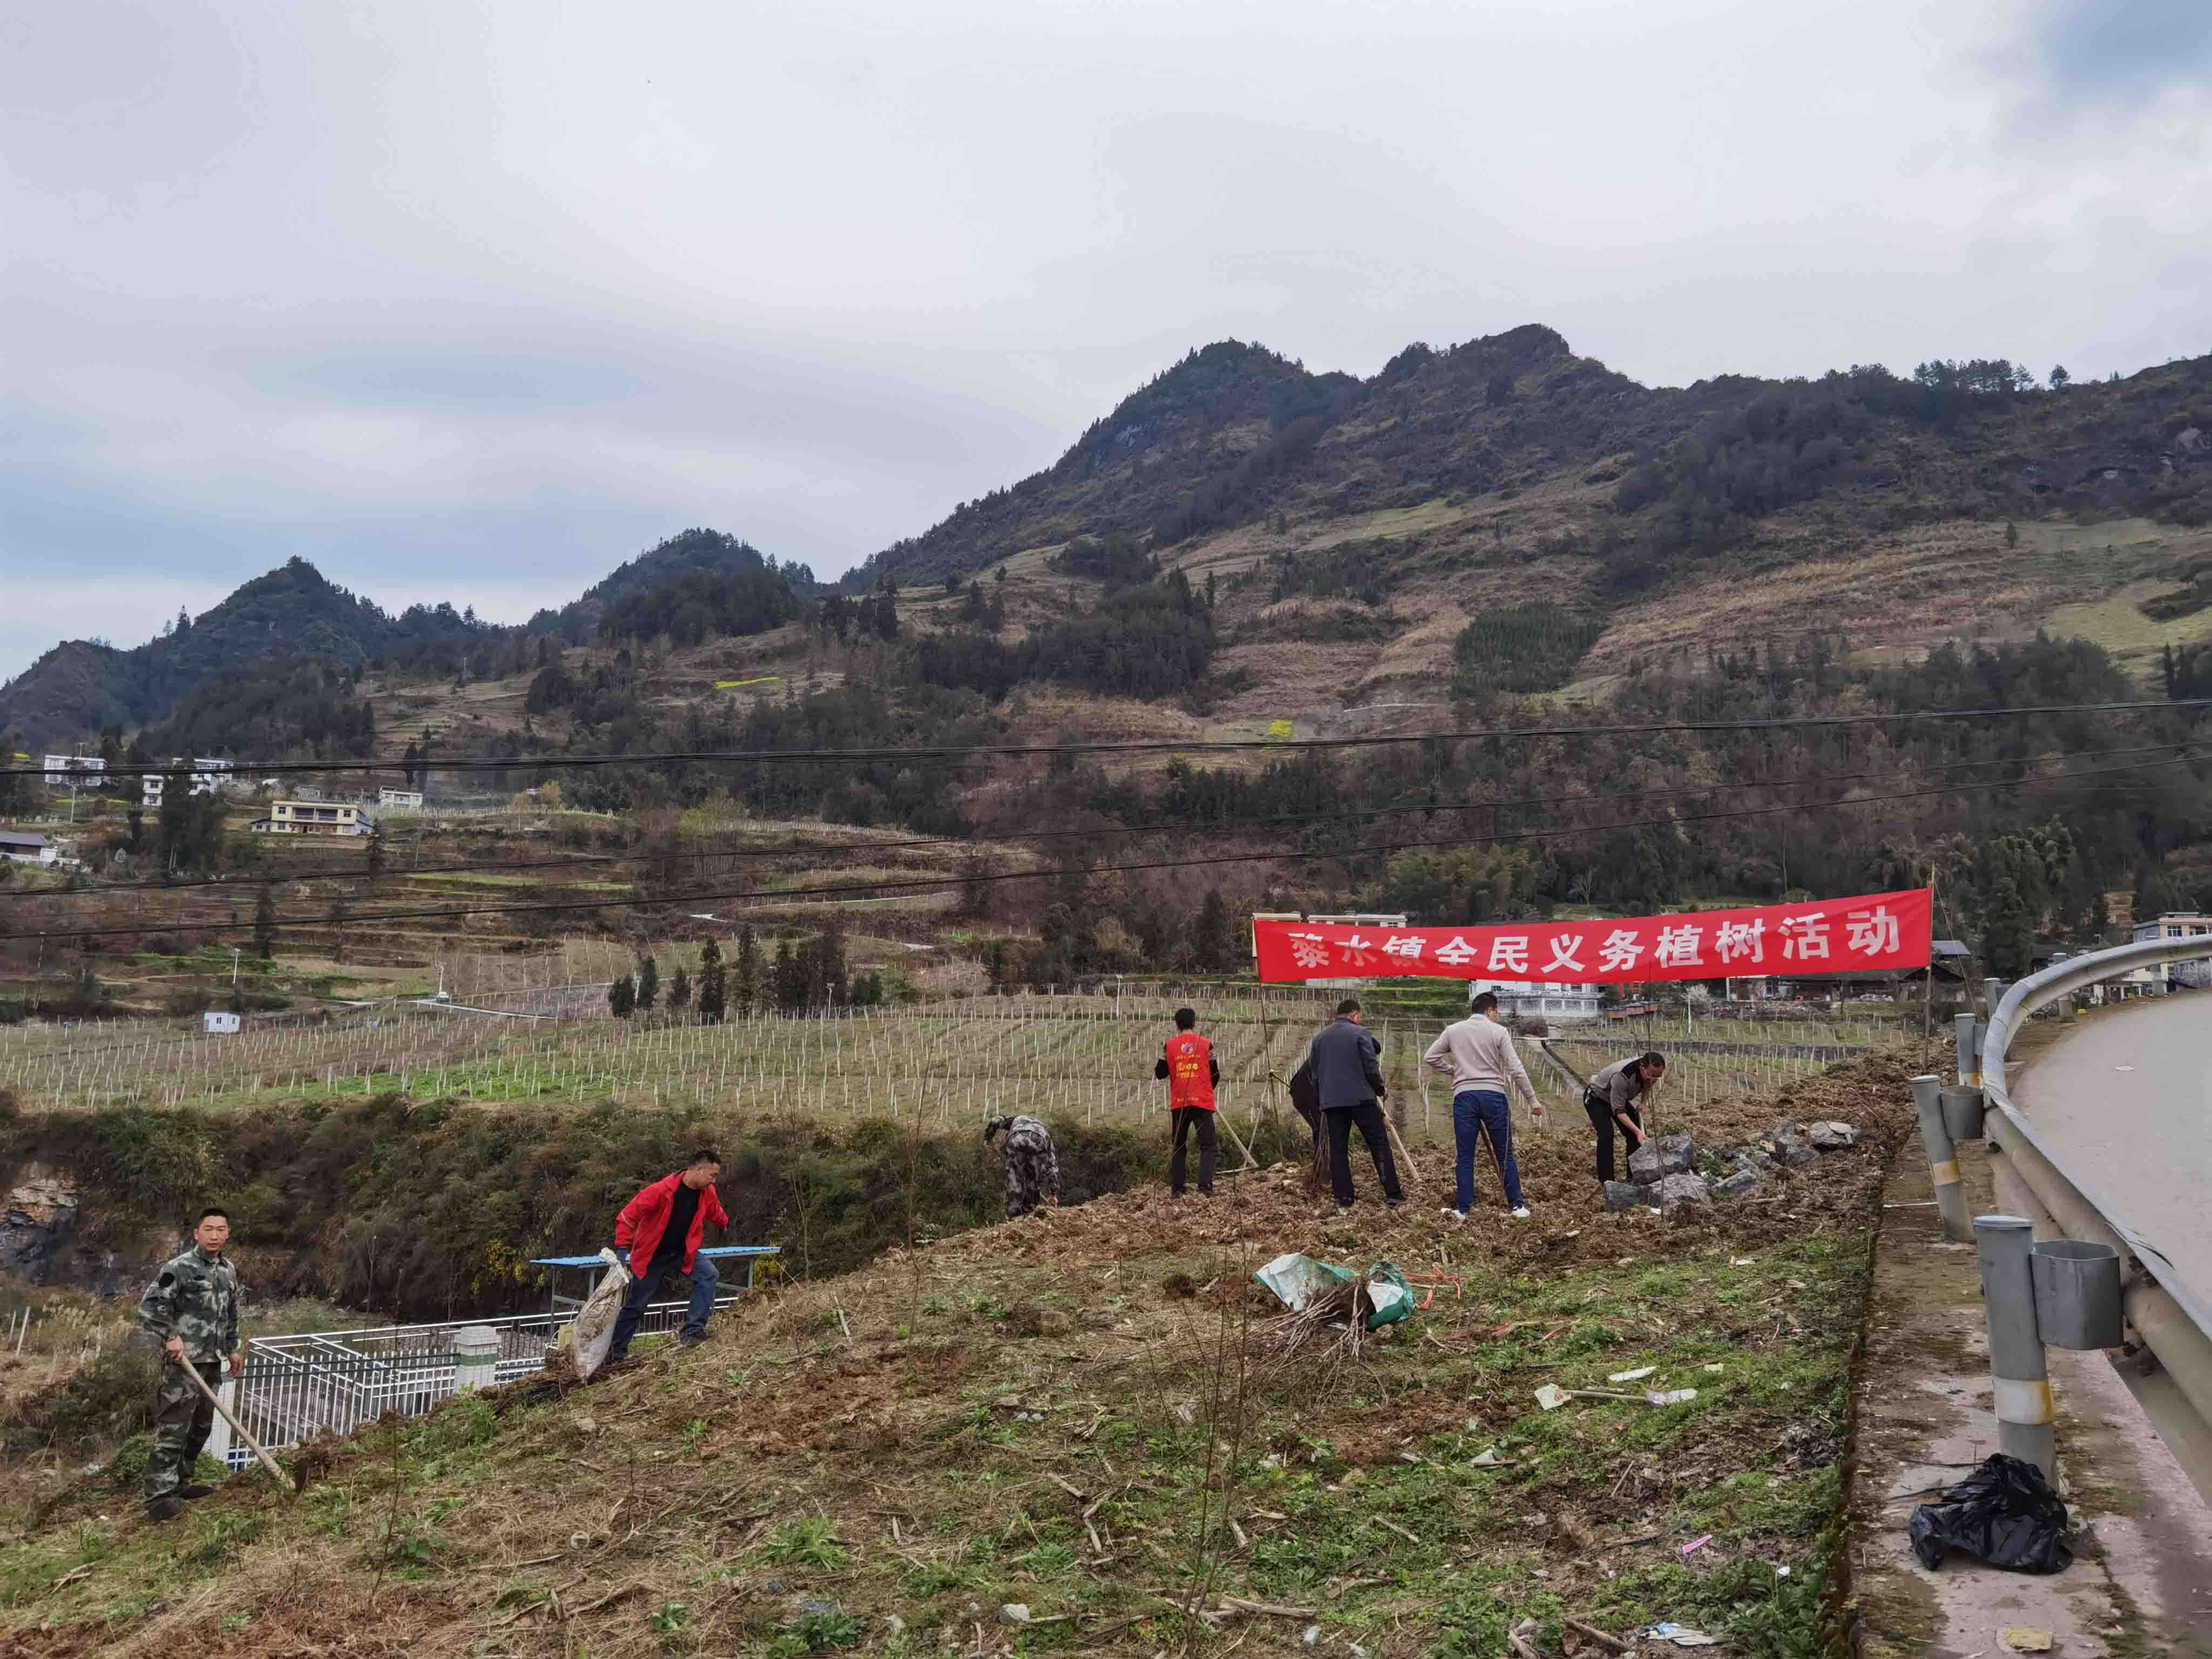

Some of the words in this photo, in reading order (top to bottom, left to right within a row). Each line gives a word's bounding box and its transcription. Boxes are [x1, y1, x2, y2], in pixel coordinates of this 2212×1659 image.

[1288, 906, 1900, 973] 黎水镇全民义务植树活动
